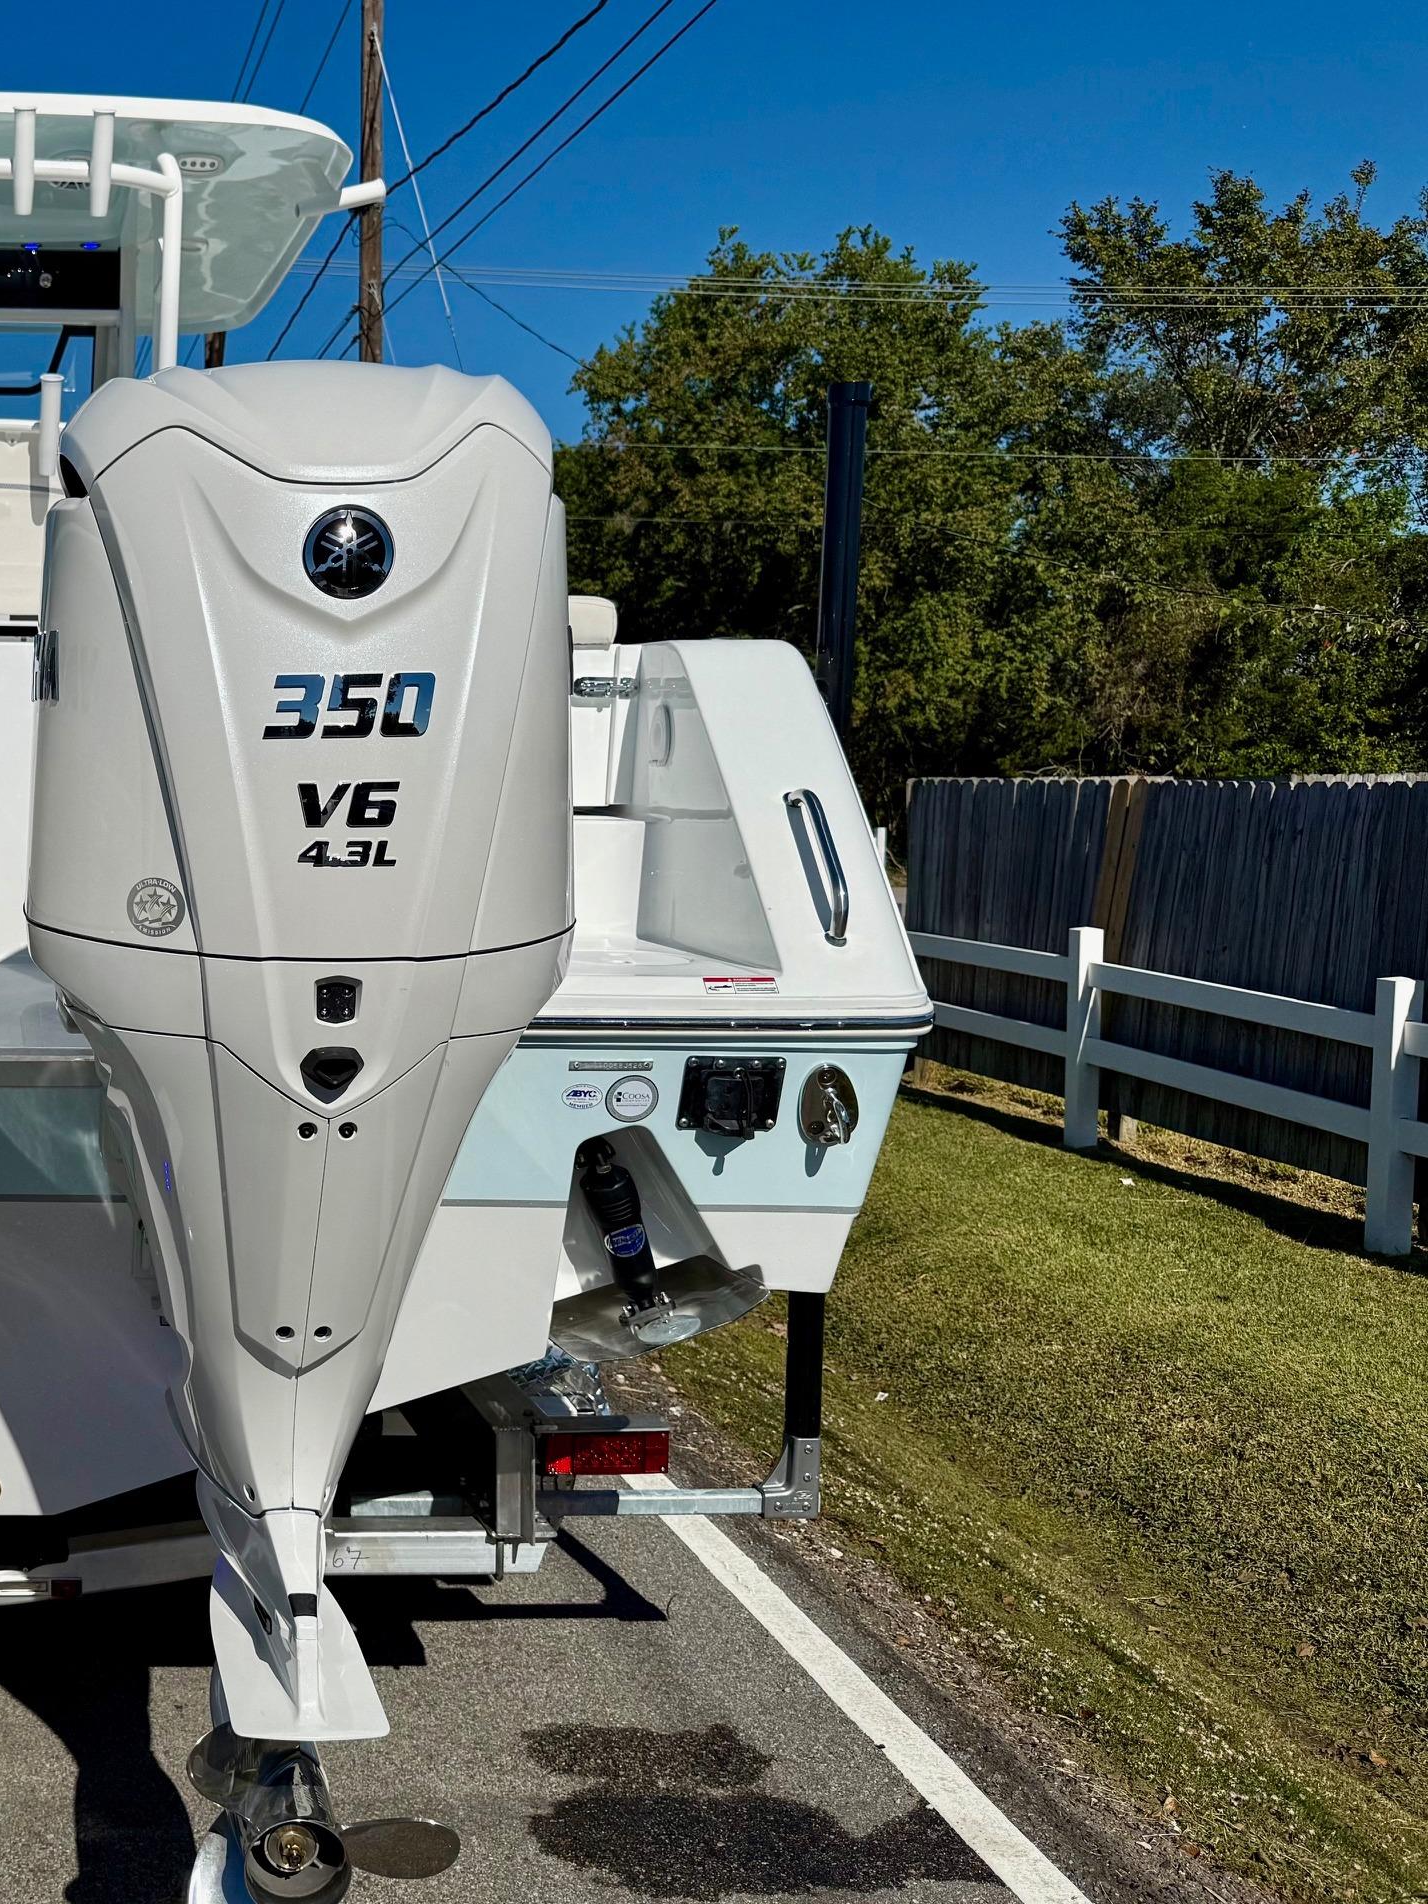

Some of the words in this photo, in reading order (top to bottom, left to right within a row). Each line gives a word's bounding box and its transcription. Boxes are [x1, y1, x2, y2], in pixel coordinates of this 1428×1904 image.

[262, 672, 436, 739] 350
[297, 781, 400, 828] V6
[297, 840, 397, 867] 4.3L
[565, 1090, 597, 1098] ABYC
[332, 1546, 370, 1570] 67
